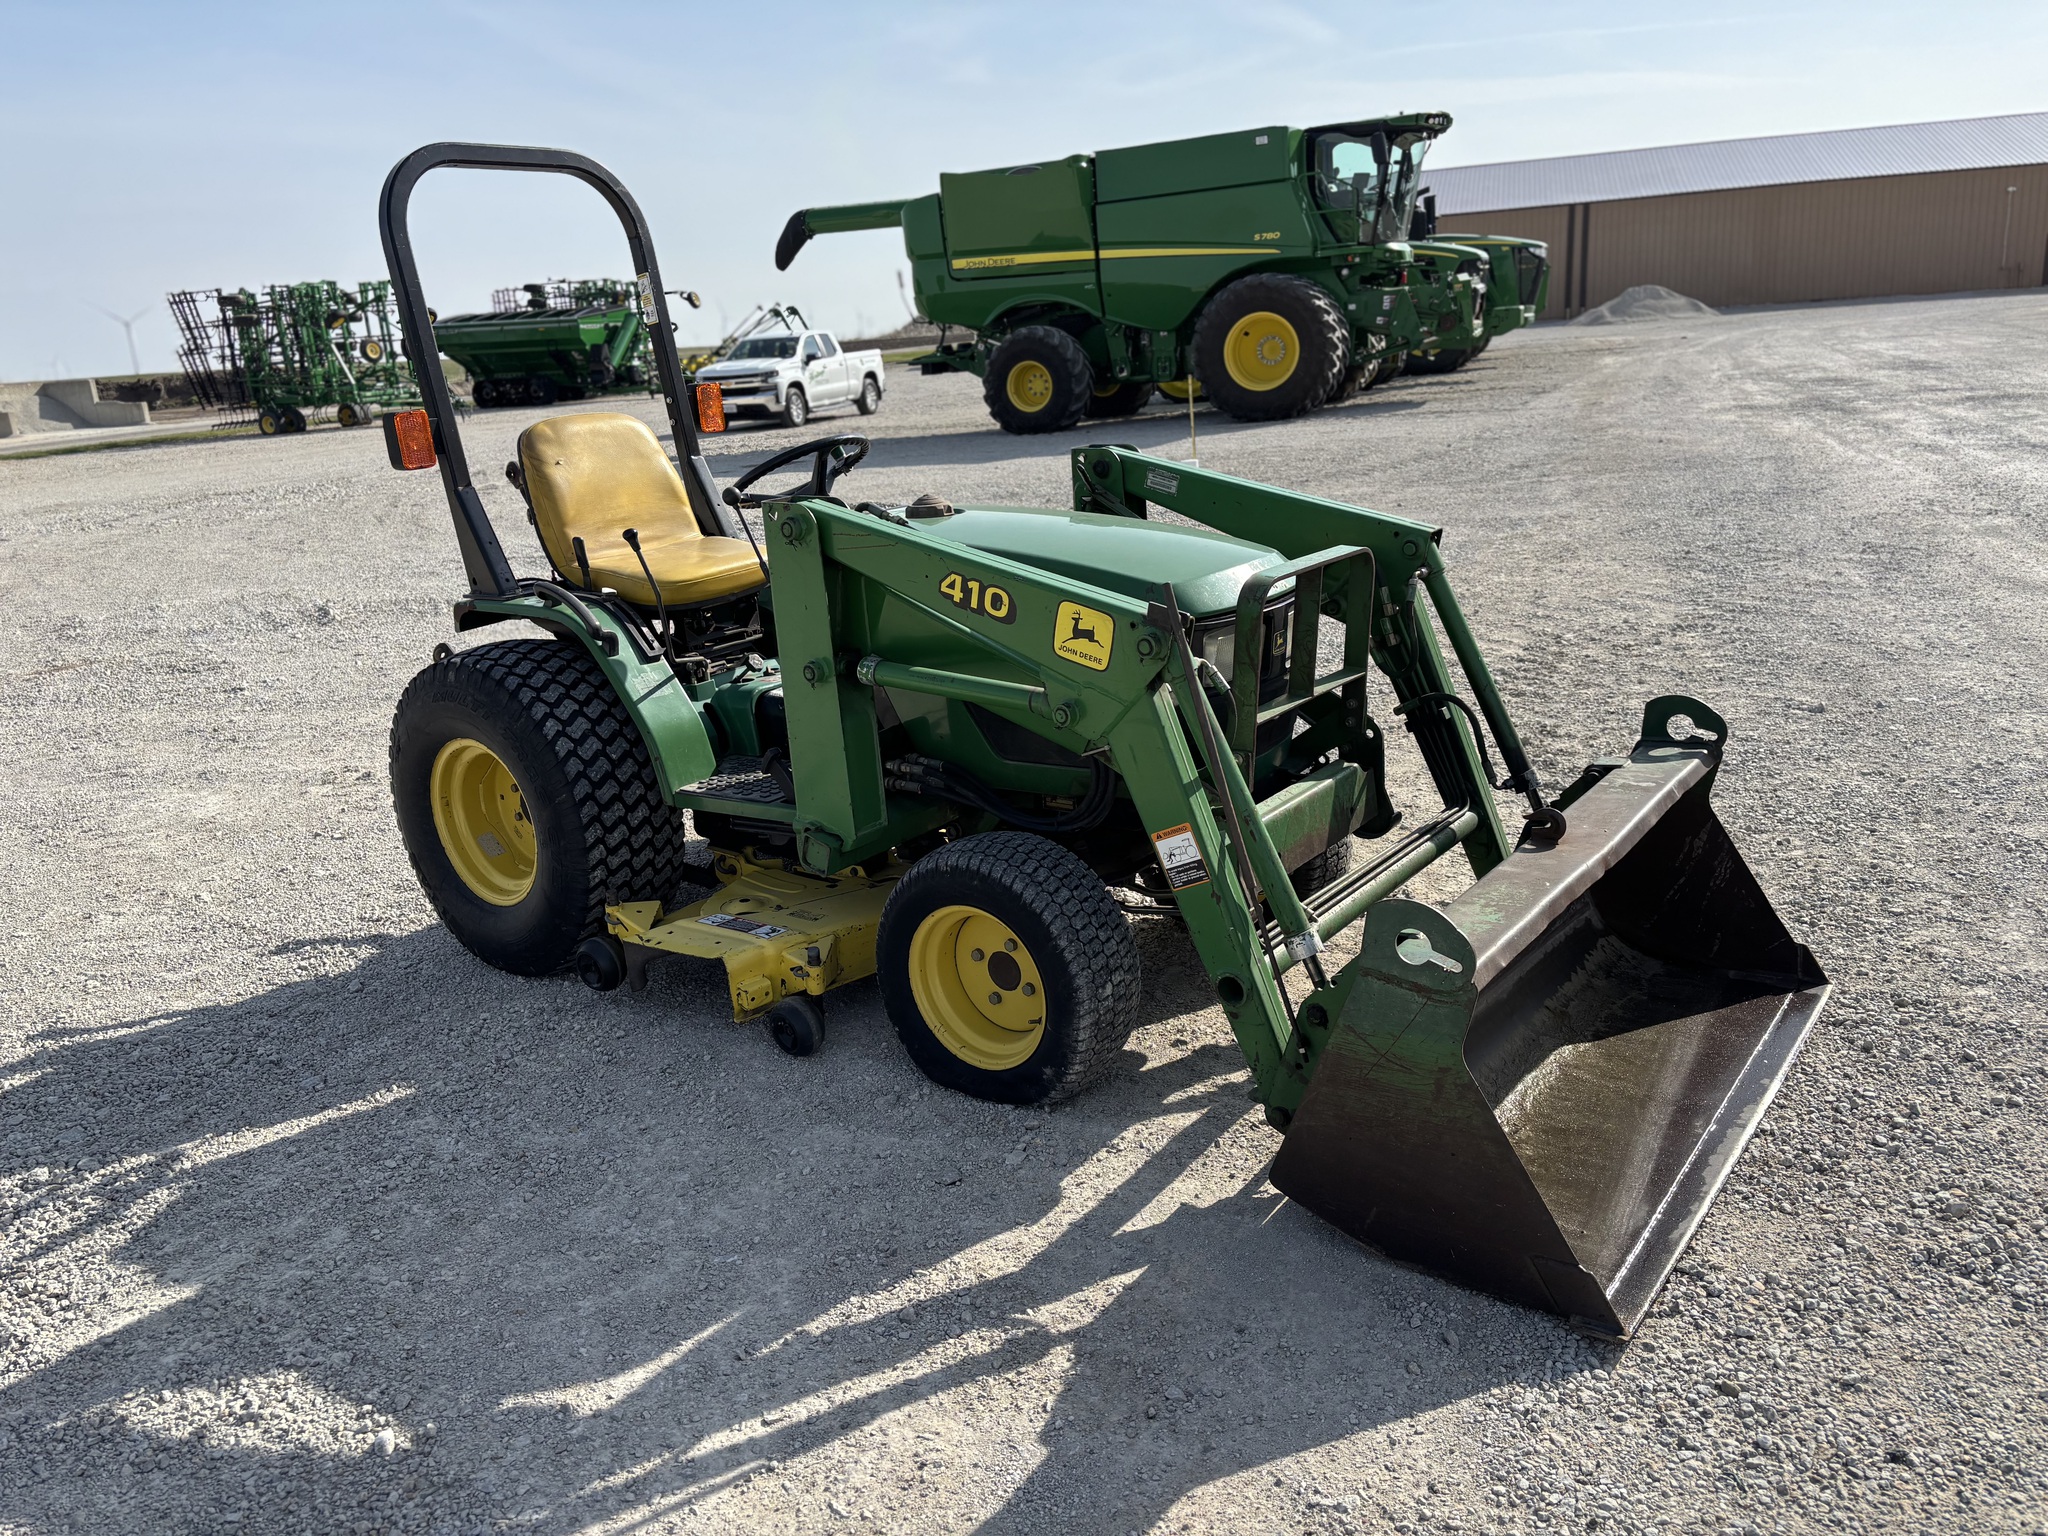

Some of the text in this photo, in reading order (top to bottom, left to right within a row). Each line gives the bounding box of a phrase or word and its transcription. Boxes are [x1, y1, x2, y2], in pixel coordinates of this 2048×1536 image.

[964, 257, 1016, 268] JOHN DEERE
[940, 573, 1010, 618] 410
[1058, 644, 1103, 666] JOHN DEERE
[1162, 826, 1187, 836] WARNING
